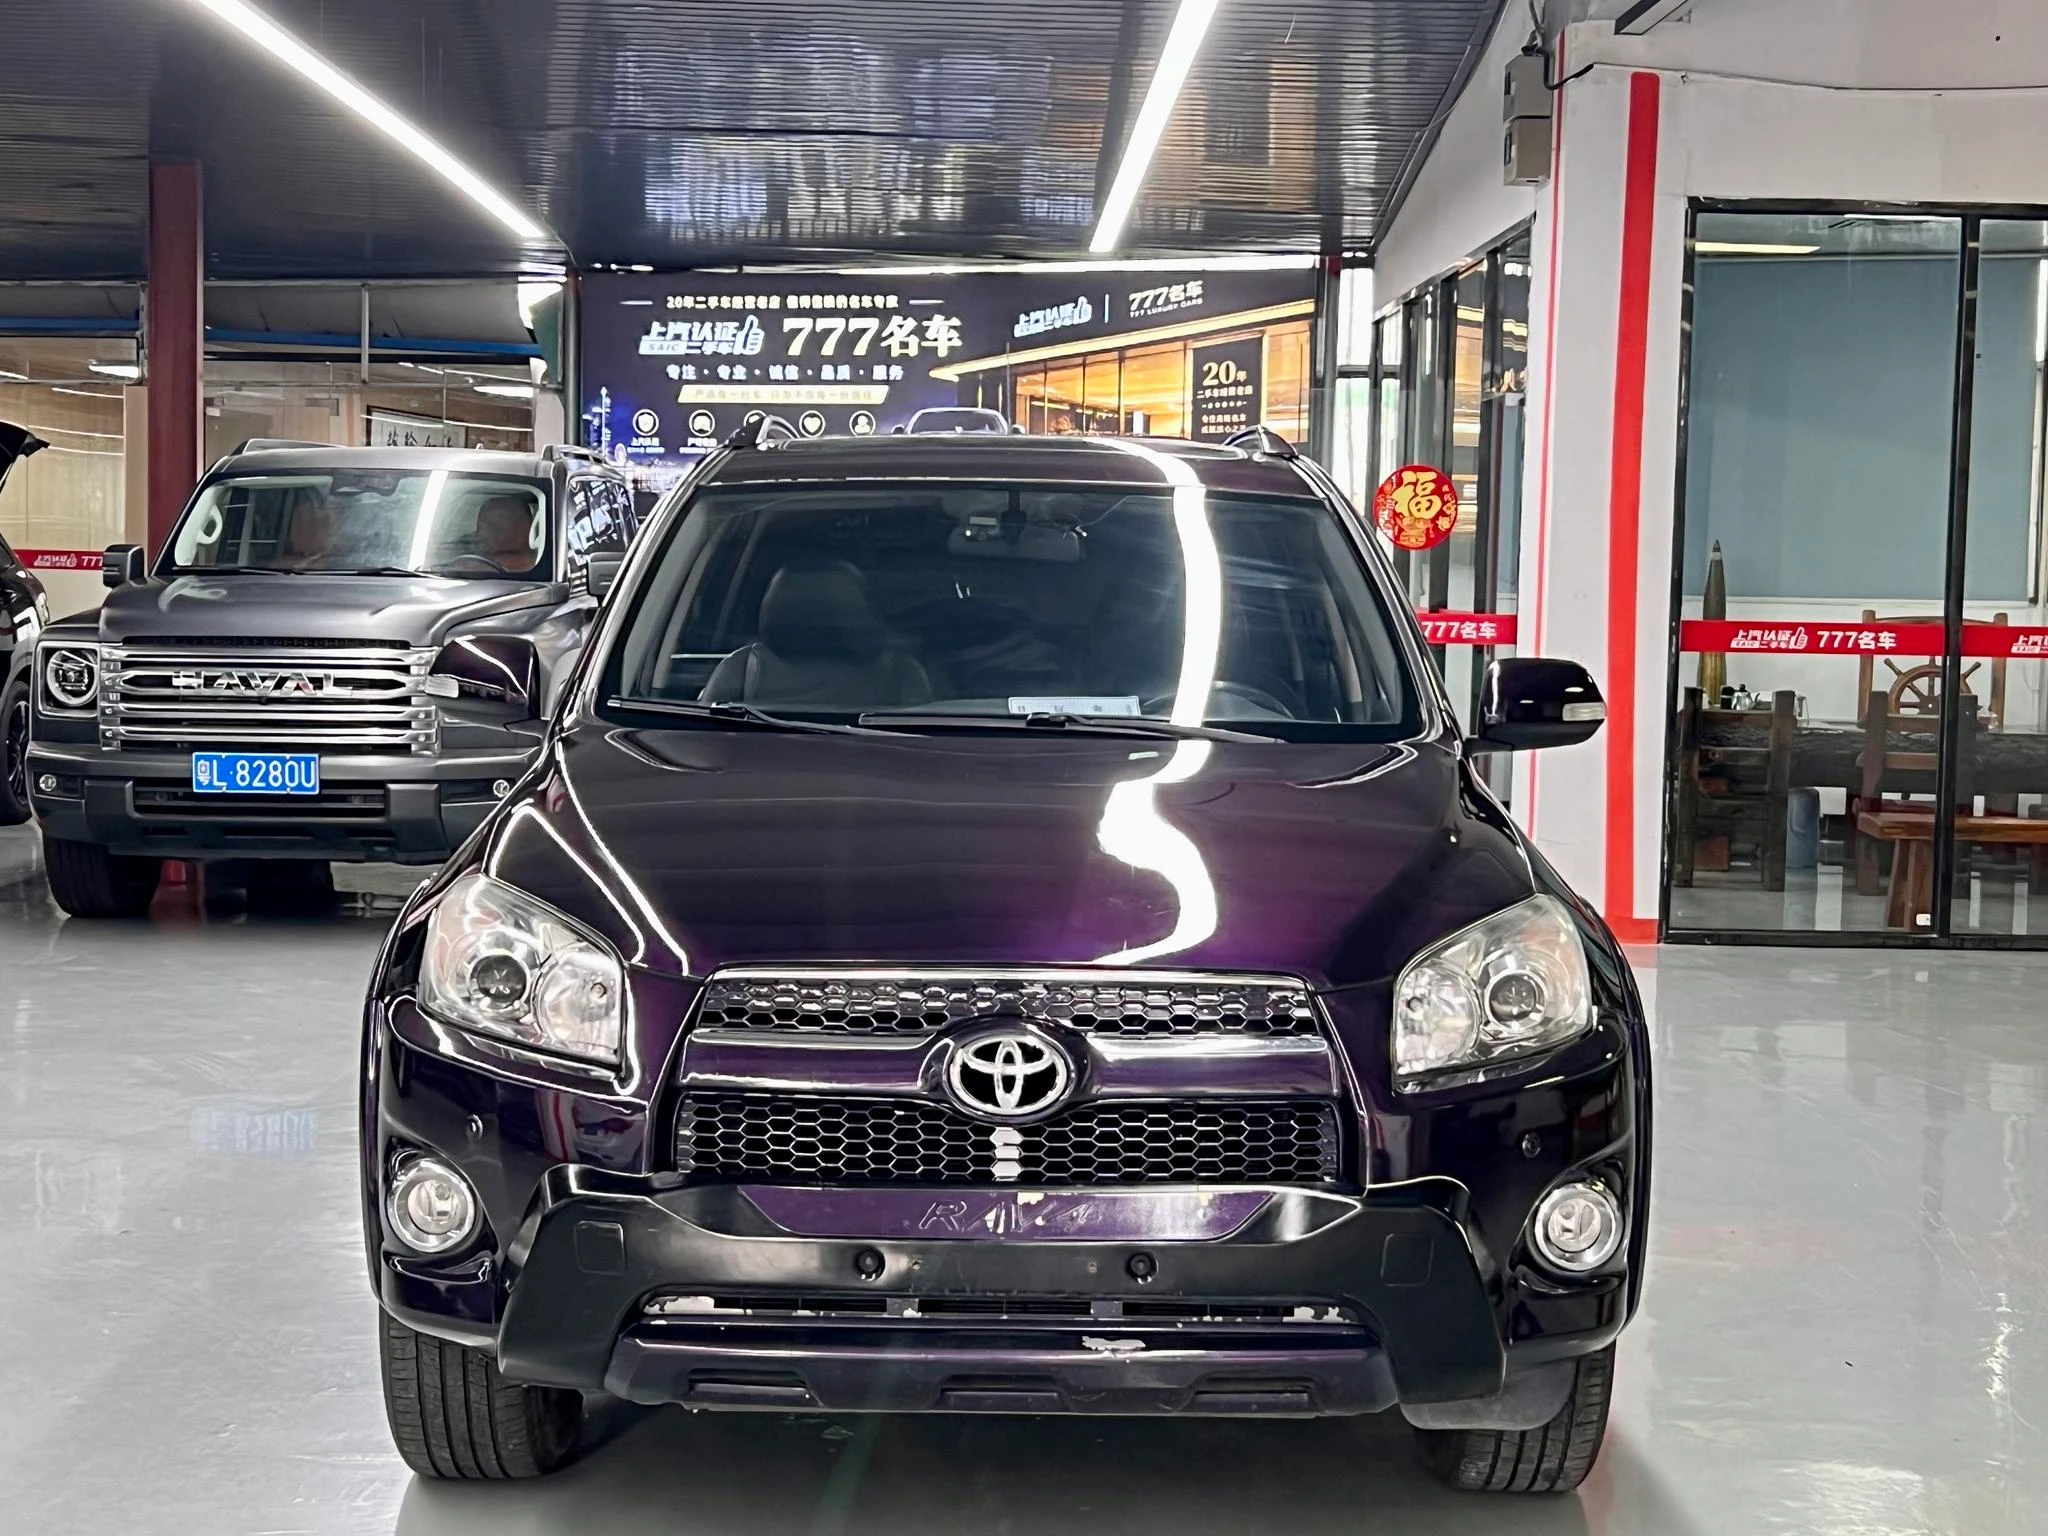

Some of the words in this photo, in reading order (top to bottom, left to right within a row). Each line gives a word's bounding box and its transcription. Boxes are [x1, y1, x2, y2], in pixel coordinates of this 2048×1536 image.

[1129, 280, 1203, 311] 777名车
[642, 321, 740, 341] 上汽认证
[783, 314, 962, 357] 777名车
[1392, 470, 1442, 520] 福
[1421, 621, 1497, 639] 777名车
[1733, 629, 1793, 641] 上汽认证
[1817, 631, 1897, 649] 777名车
[172, 671, 353, 695] HAVAL
[919, 1200, 1092, 1233] RAV4
